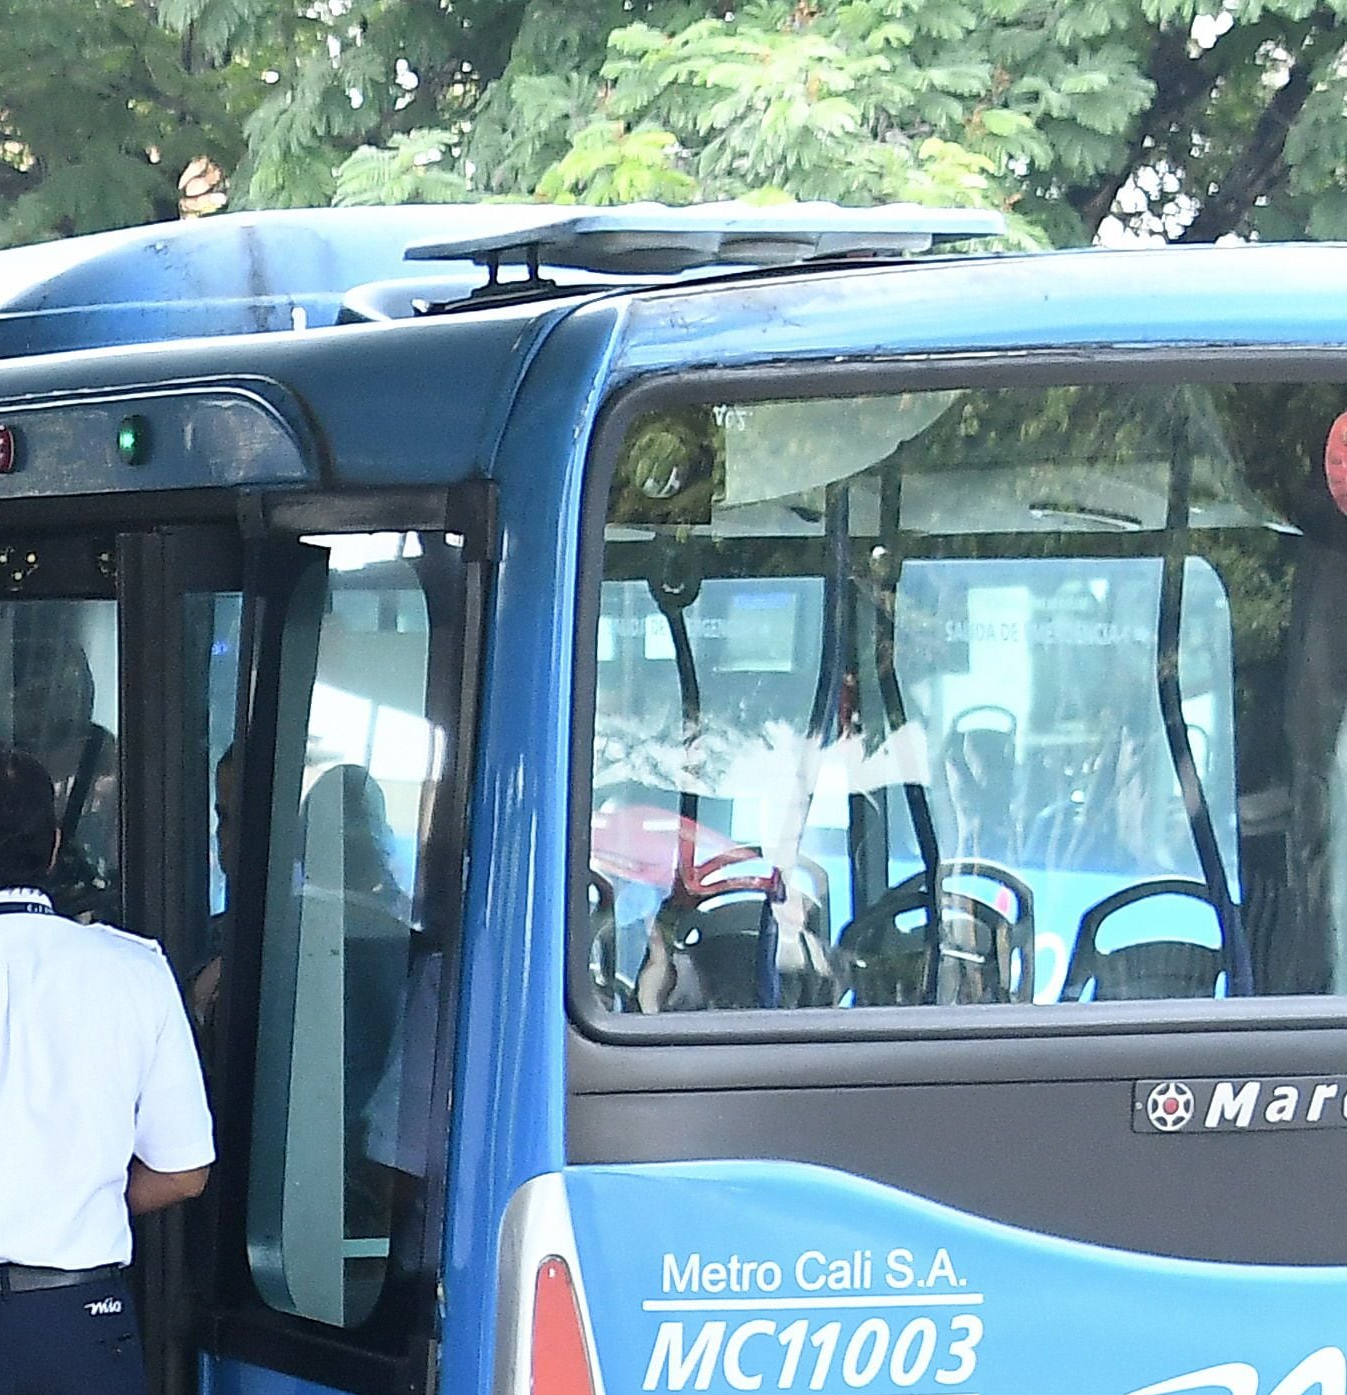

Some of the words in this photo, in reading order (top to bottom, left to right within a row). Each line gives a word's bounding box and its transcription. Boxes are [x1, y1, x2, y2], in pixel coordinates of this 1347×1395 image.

[1204, 1081, 1347, 1128] Mar
[661, 1252, 782, 1293] Metro
[795, 1250, 872, 1290] Cali
[885, 1247, 968, 1289] S.A.
[641, 1313, 985, 1392] MC11003
